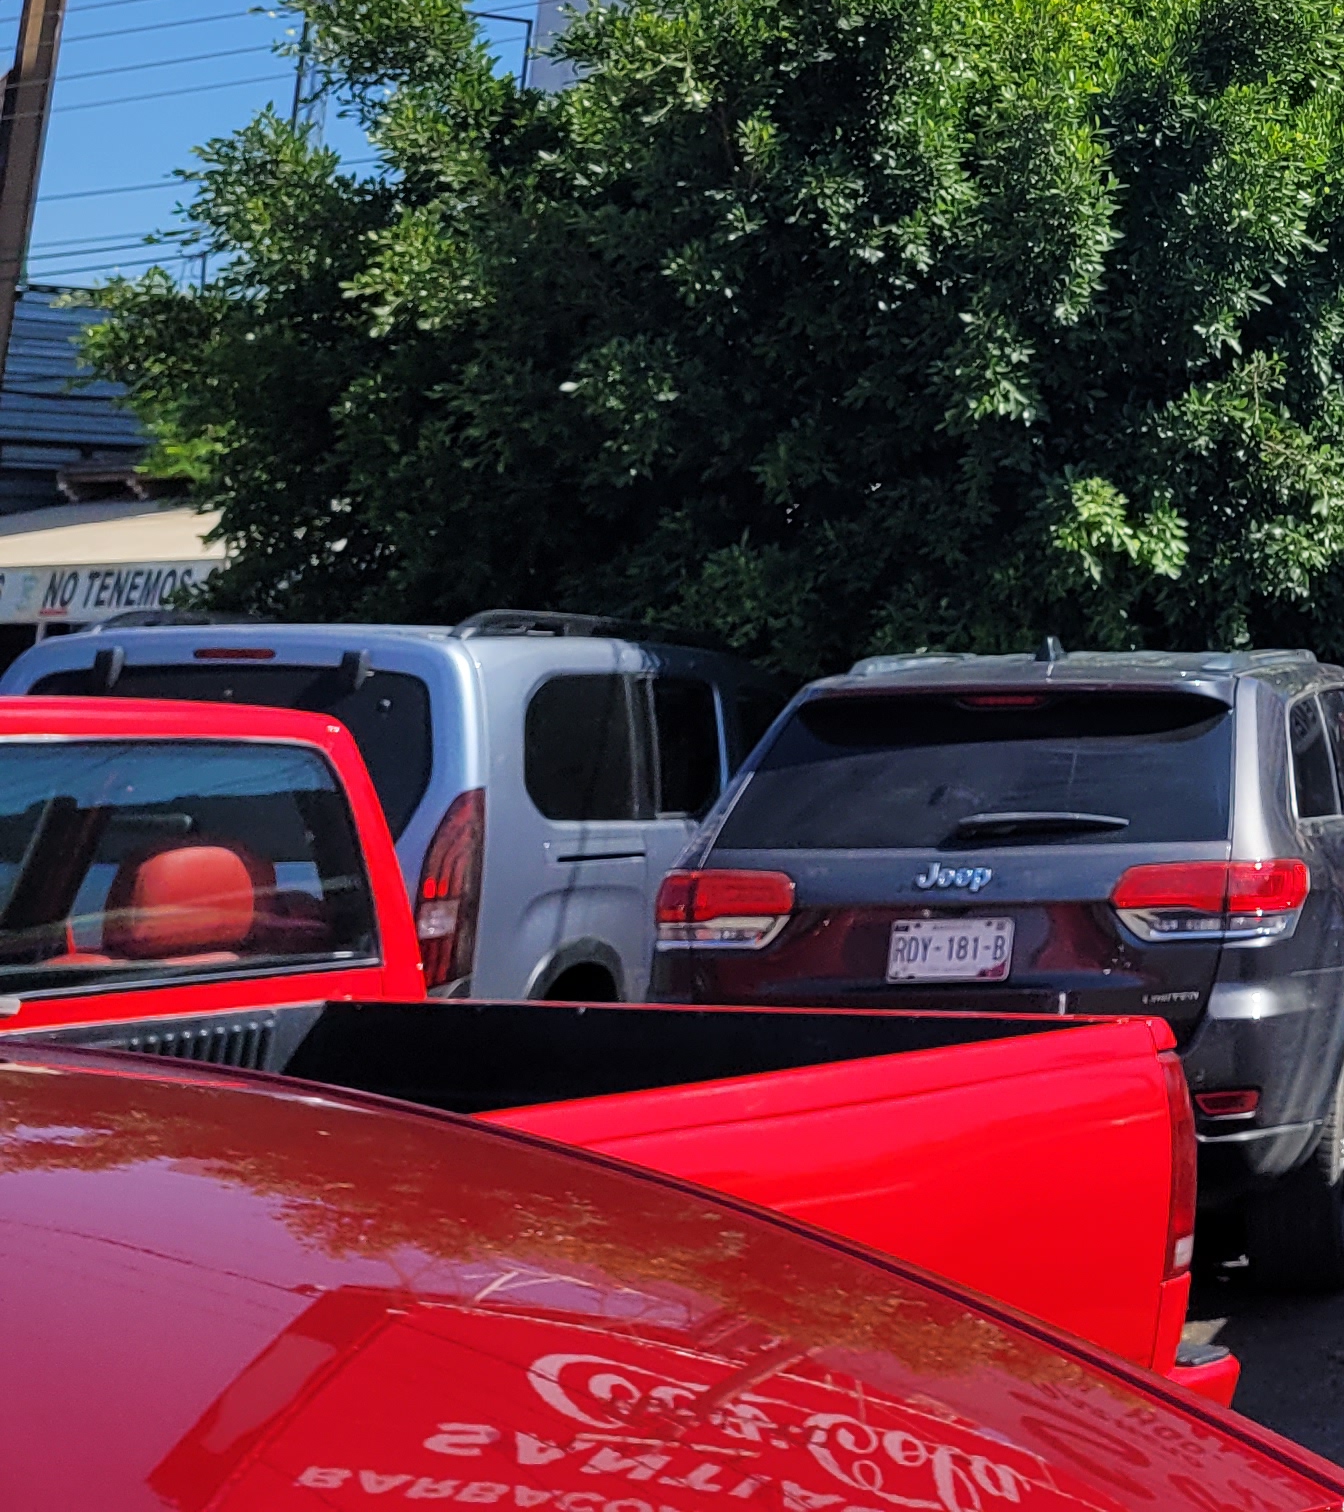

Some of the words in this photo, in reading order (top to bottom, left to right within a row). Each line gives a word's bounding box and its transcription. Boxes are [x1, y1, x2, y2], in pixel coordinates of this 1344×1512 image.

[42, 571, 79, 608] NO
[916, 862, 992, 892] Jeep
[892, 935, 1006, 963] RDY-181-B
